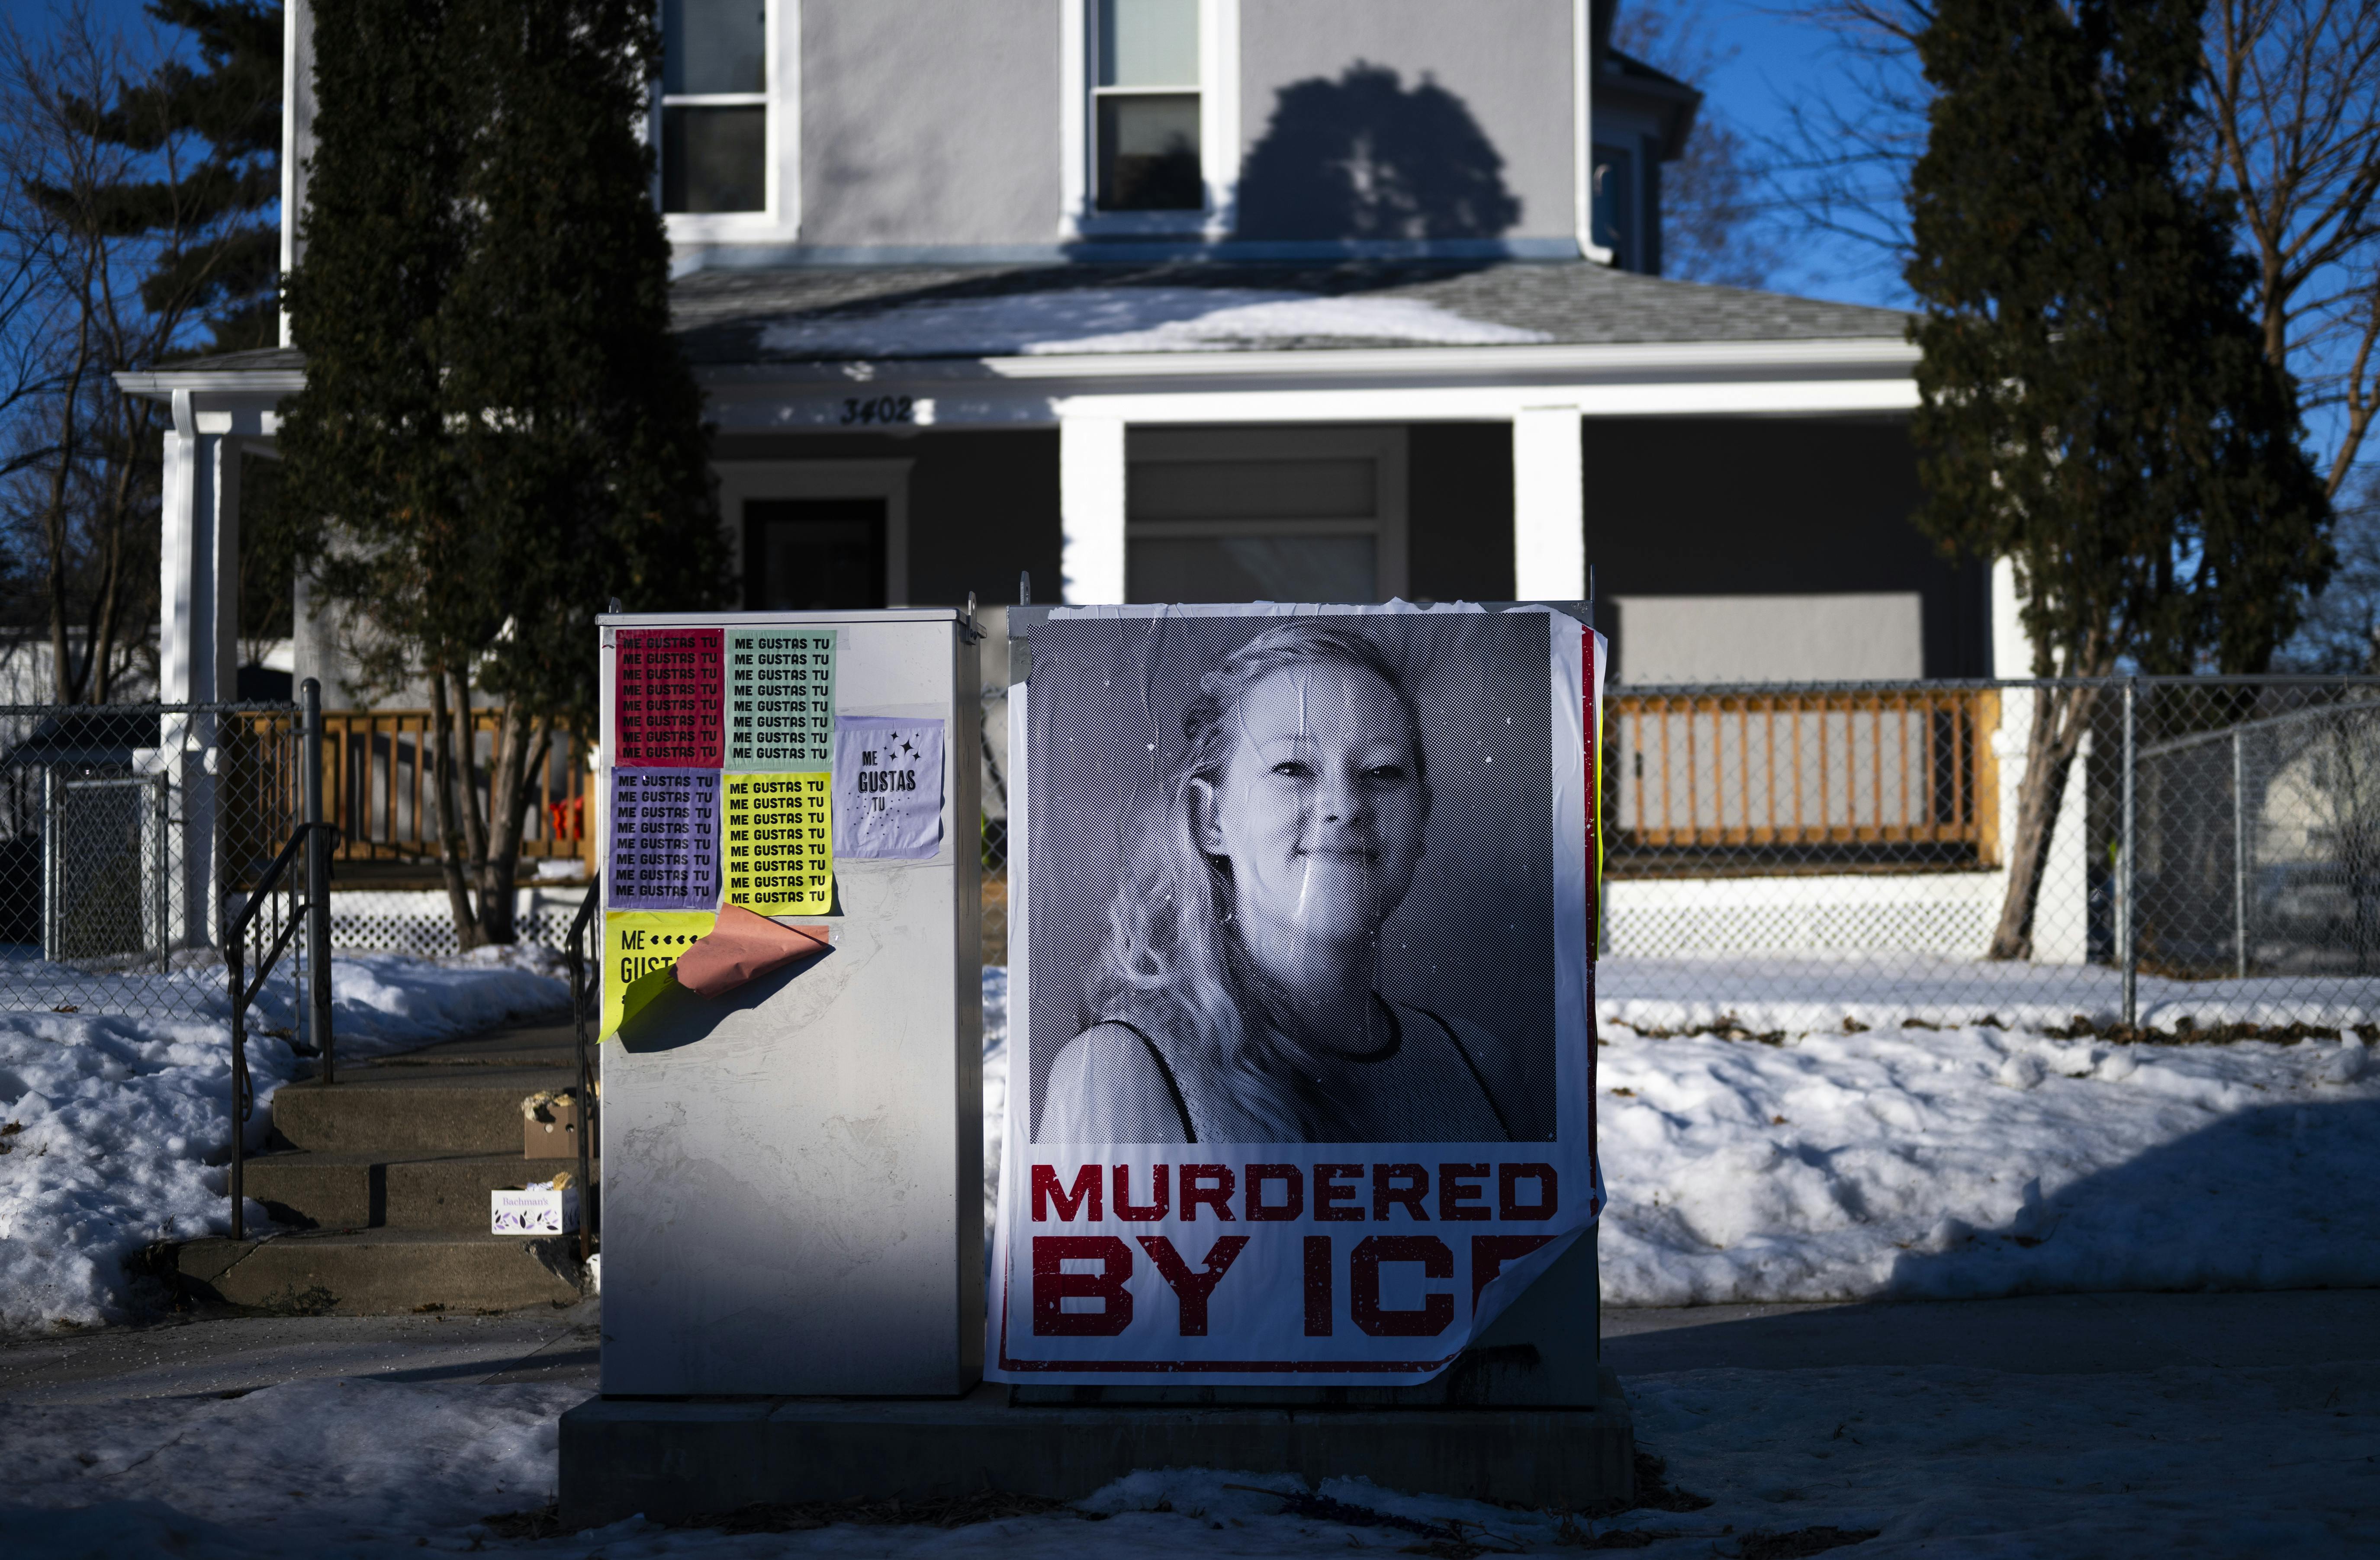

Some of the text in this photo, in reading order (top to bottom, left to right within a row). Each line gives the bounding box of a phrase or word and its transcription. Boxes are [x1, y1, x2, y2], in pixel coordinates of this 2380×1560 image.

[840, 395, 913, 425] 3402
[623, 637, 717, 649] ME GUSTAS TU
[735, 639, 829, 649] ME GUSTAS TU
[624, 652, 717, 664] ME GUSTAS TU
[735, 654, 829, 665] ME GUSTAS TU
[623, 668, 717, 680] ME GUSTAS TU
[735, 670, 828, 680] ME GUSTAS TU
[623, 684, 717, 695] ME GUSTAS TU
[735, 685, 828, 696] ME GUSTAS TU
[623, 700, 717, 712] ME GUSTAS TU
[734, 701, 828, 712] ME GUSTAS TU
[623, 715, 717, 727] ME GUSTAS TU
[734, 716, 828, 728] ME GUSTAS TU
[623, 731, 717, 743] ME GUSTAS TU
[733, 732, 827, 743] ME GUSTAS TU
[623, 746, 716, 758] ME GUSTAS TU
[733, 748, 827, 759] ME GUSTAS TU
[862, 751, 878, 766] ME
[619, 776, 713, 787] ME GUSTAS TU
[730, 781, 823, 794] ME GUSTAS TU
[858, 770, 916, 793] GUSTAS
[618, 791, 712, 803] ME GUSTAS TU
[730, 797, 823, 809] ME GUSTAS TU
[872, 796, 885, 812] TU
[618, 807, 711, 819] ME GUSTAS TU
[730, 812, 824, 825] ME GUSTAS TU
[618, 822, 711, 834] ME GUSTAS TU
[731, 828, 824, 841] ME GUSTAS TU
[618, 838, 710, 850] ME GUSTAS TU
[731, 844, 825, 856] ME GUSTAS TU
[617, 854, 710, 865] ME GUSTAS TU
[731, 860, 825, 872] ME GUSTAS TU
[616, 869, 709, 881] ME GUSTAS TU
[731, 876, 825, 888] ME GUSTAS TU
[616, 885, 709, 896] ME GUSTAS TU
[732, 891, 824, 903] ME GUSTAS TU
[621, 930, 645, 950] ME
[621, 957, 680, 983] GUST
[1031, 1163, 1558, 1221] MURDERED
[503, 1197, 548, 1206] Bachman's
[1032, 1236, 1251, 1336] BY
